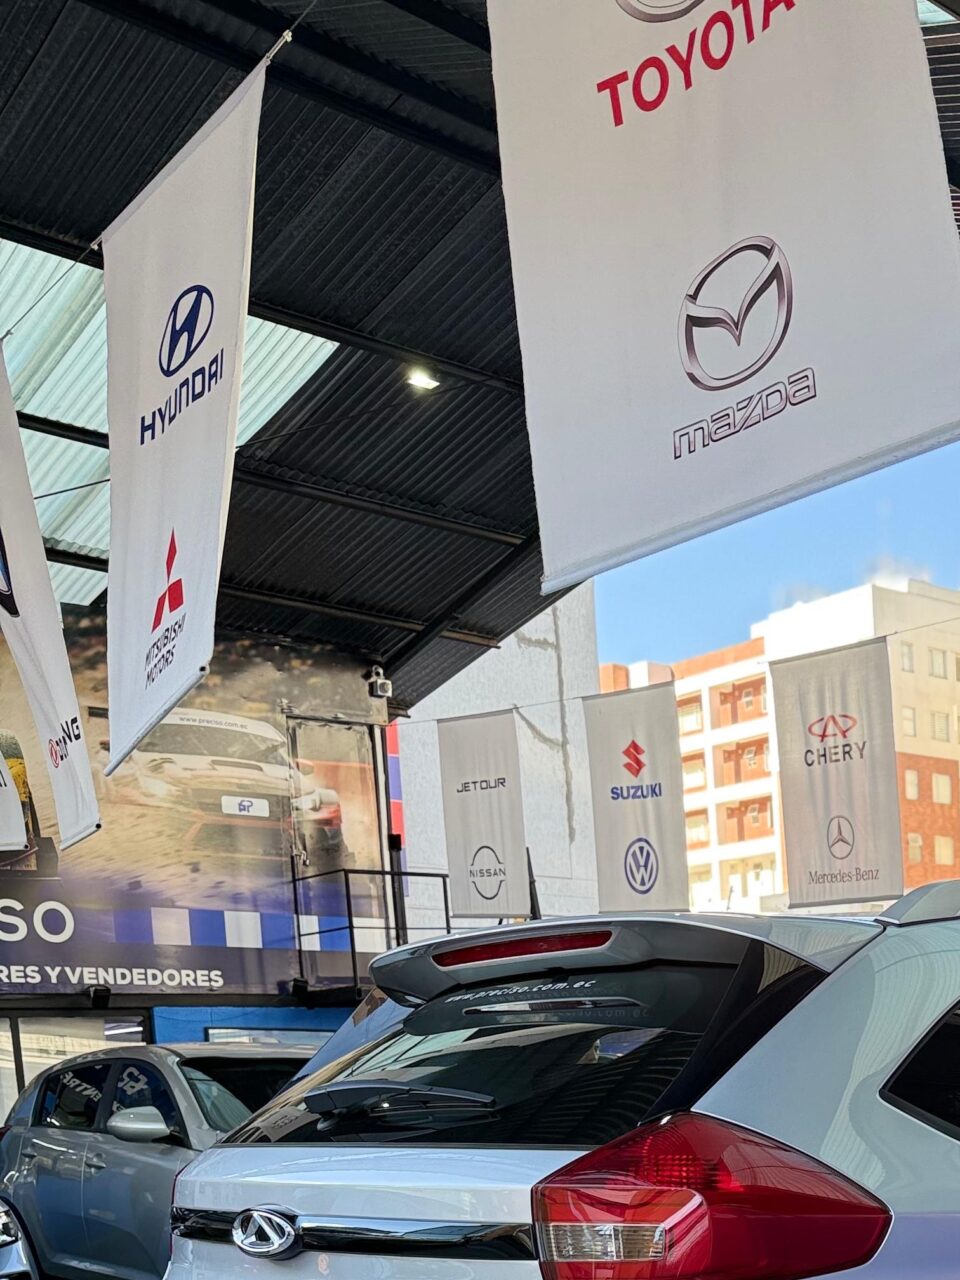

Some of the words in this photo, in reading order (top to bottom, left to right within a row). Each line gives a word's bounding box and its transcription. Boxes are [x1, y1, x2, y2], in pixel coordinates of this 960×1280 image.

[140, 347, 224, 446] HYUNDAI
[144, 612, 187, 672] MITSUBISHI
[145, 643, 176, 690] MOTORS
[803, 741, 868, 768] CHERY
[456, 777, 507, 794] JETOUR
[610, 782, 663, 801] SUZUKI
[469, 866, 507, 877] NISSAN
[808, 868, 880, 886] Mercedes-Benz
[45, 966, 62, 984] Y
[64, 967, 224, 988] VENDEDORES
